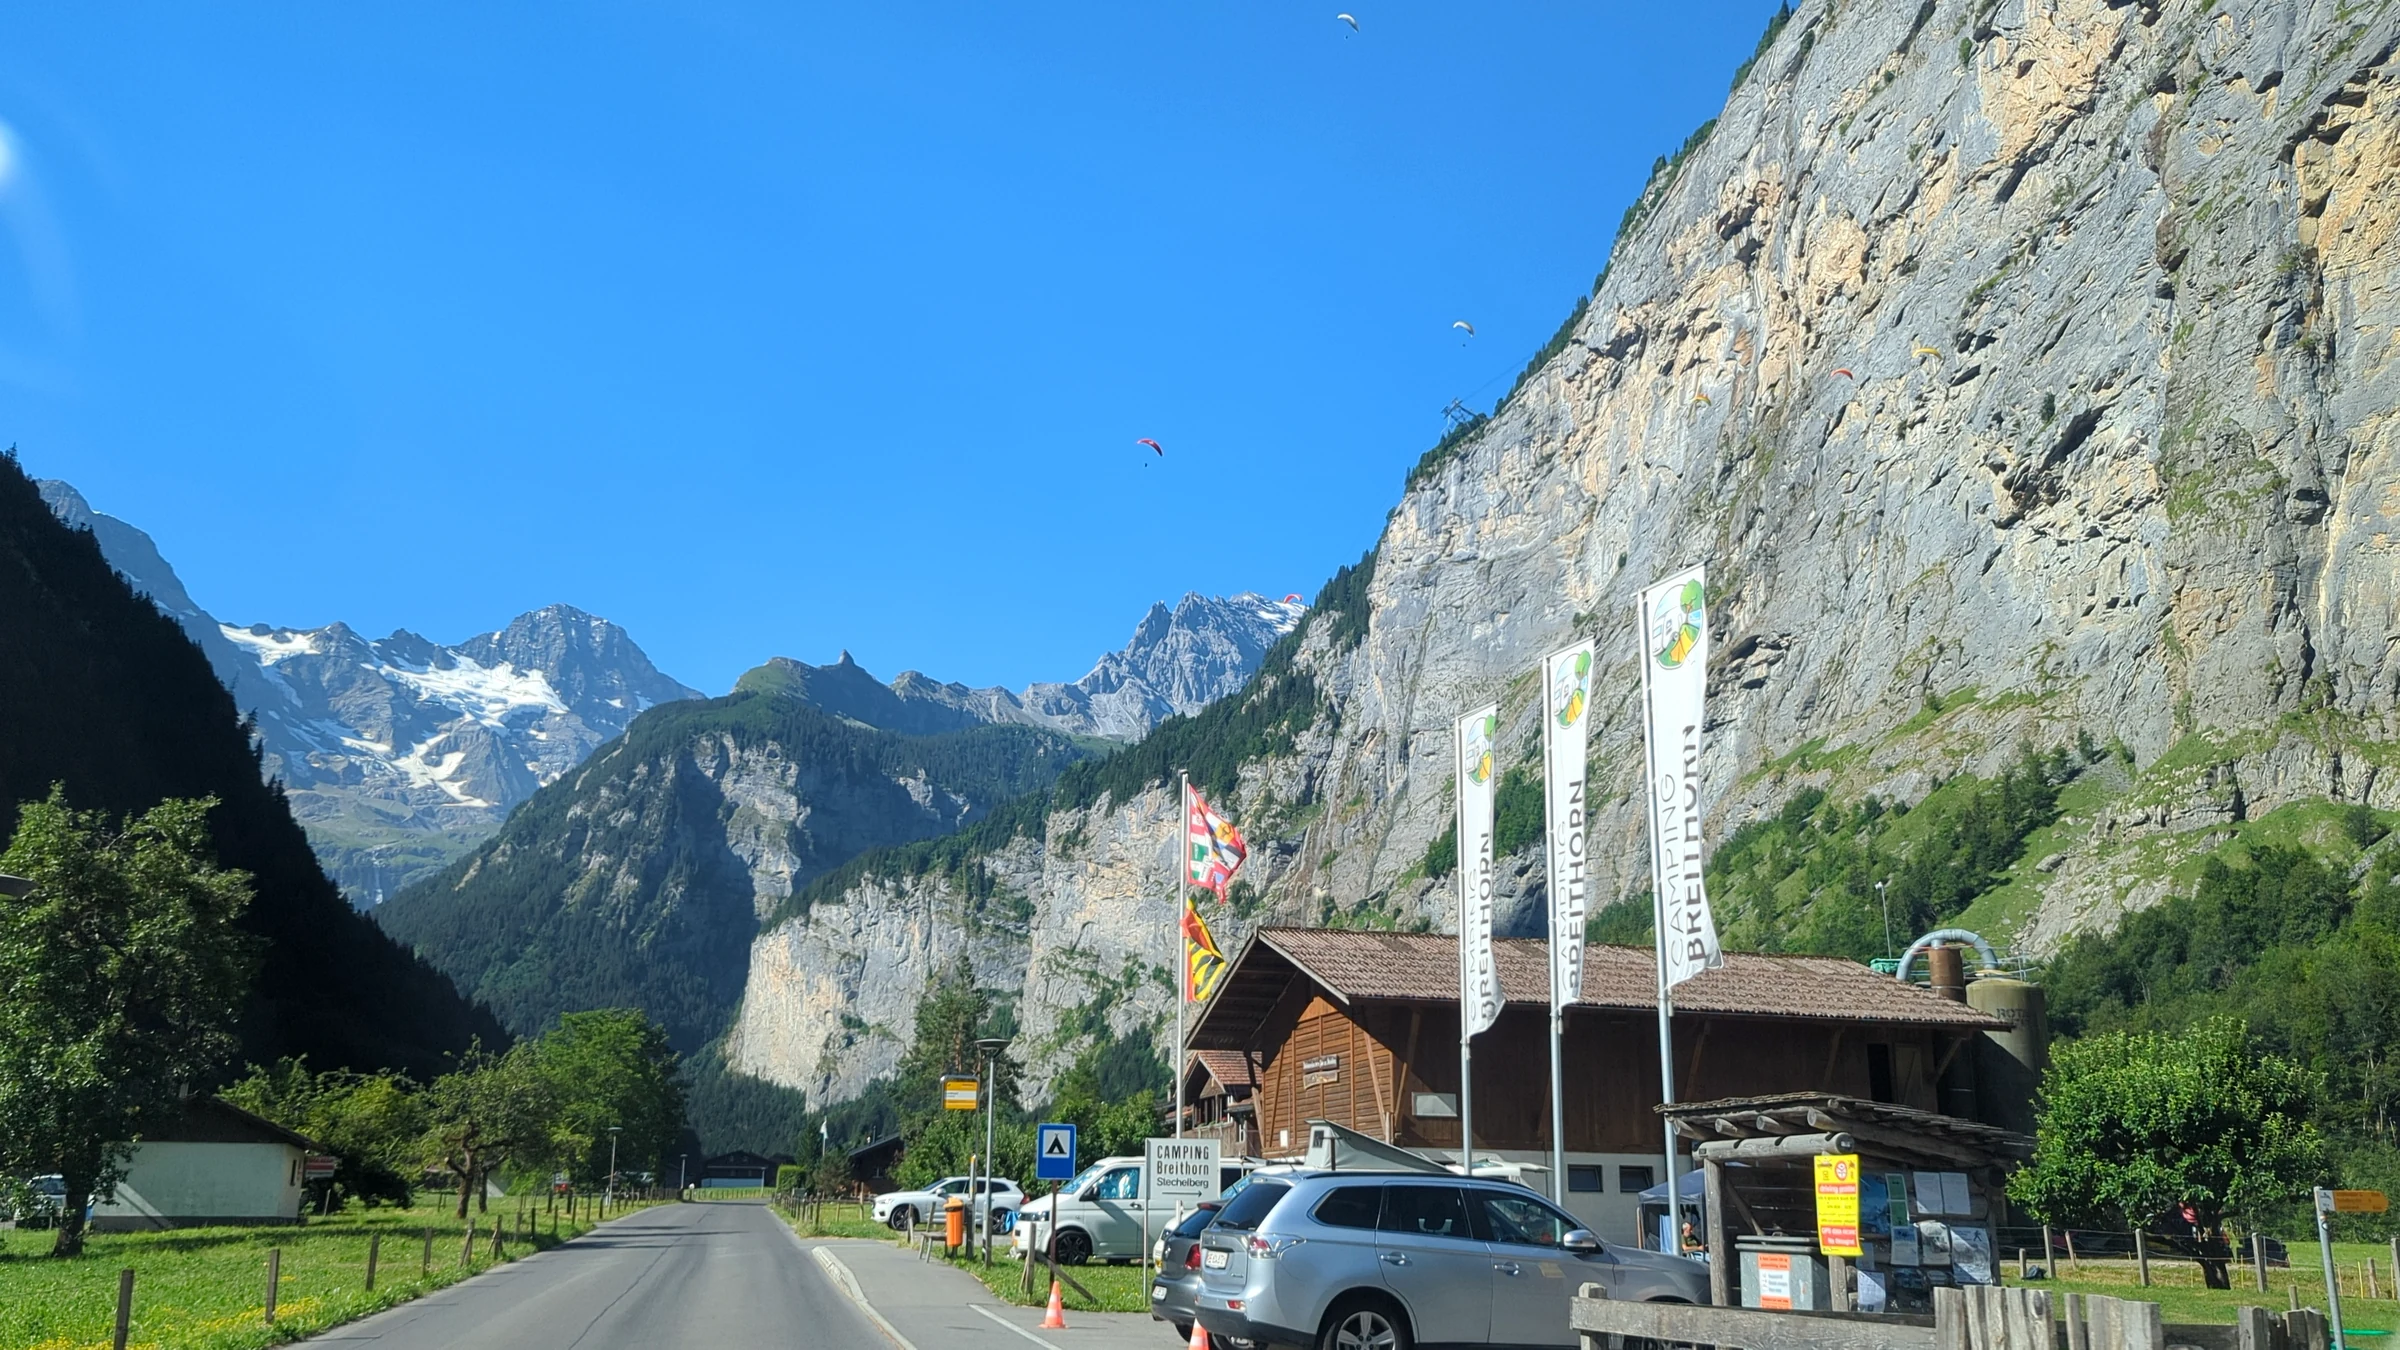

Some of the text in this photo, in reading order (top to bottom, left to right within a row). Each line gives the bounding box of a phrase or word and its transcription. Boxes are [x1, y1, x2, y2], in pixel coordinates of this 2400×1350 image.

[1479, 833, 1495, 1020] BREITHORN
[1568, 779, 1584, 989] BREITHORN
[1659, 772, 1684, 967] CAMPING
[1682, 725, 1707, 962] BREITHORN
[1157, 1145, 1209, 1160] CAMPING
[1157, 1160, 1209, 1175] Breithorn
[1157, 1176, 1209, 1189] Stechelberg
